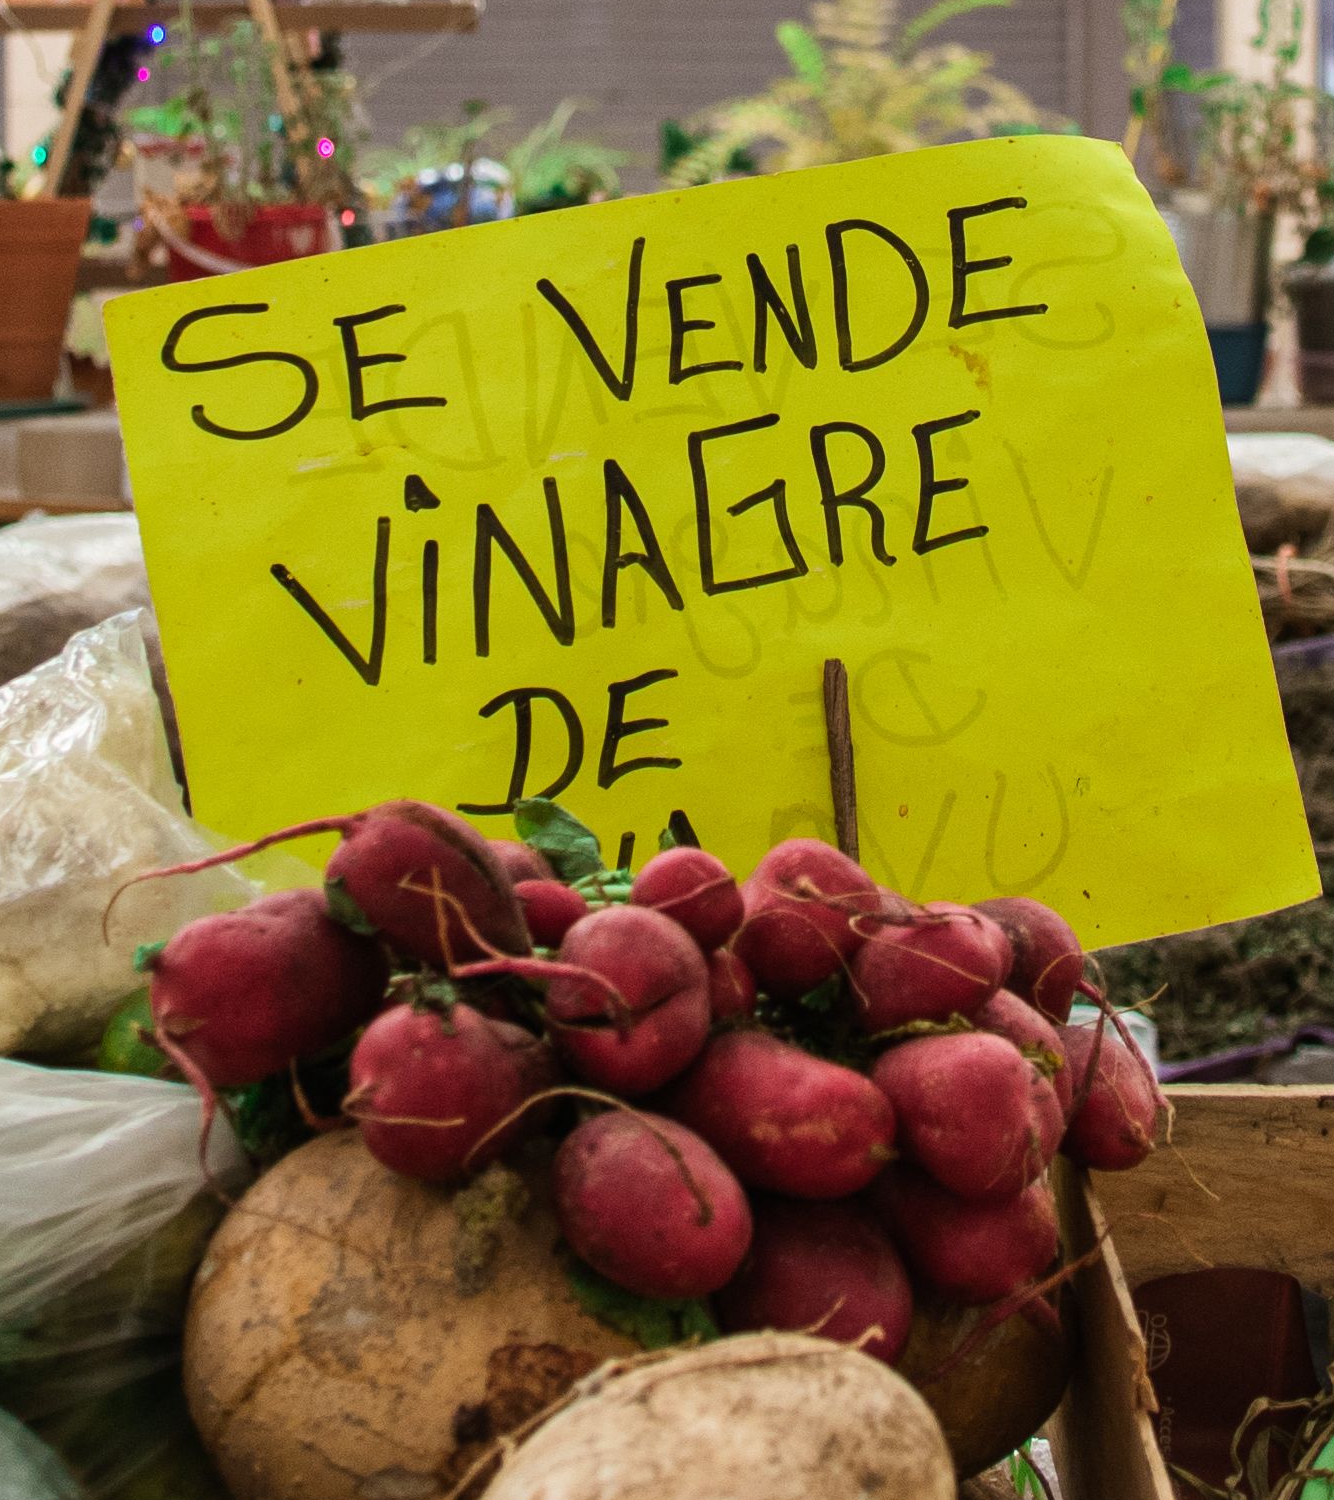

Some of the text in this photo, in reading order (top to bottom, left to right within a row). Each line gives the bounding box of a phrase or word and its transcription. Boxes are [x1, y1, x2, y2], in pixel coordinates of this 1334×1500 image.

[160, 196, 1048, 440] SE VENDE
[457, 668, 683, 816] DE
